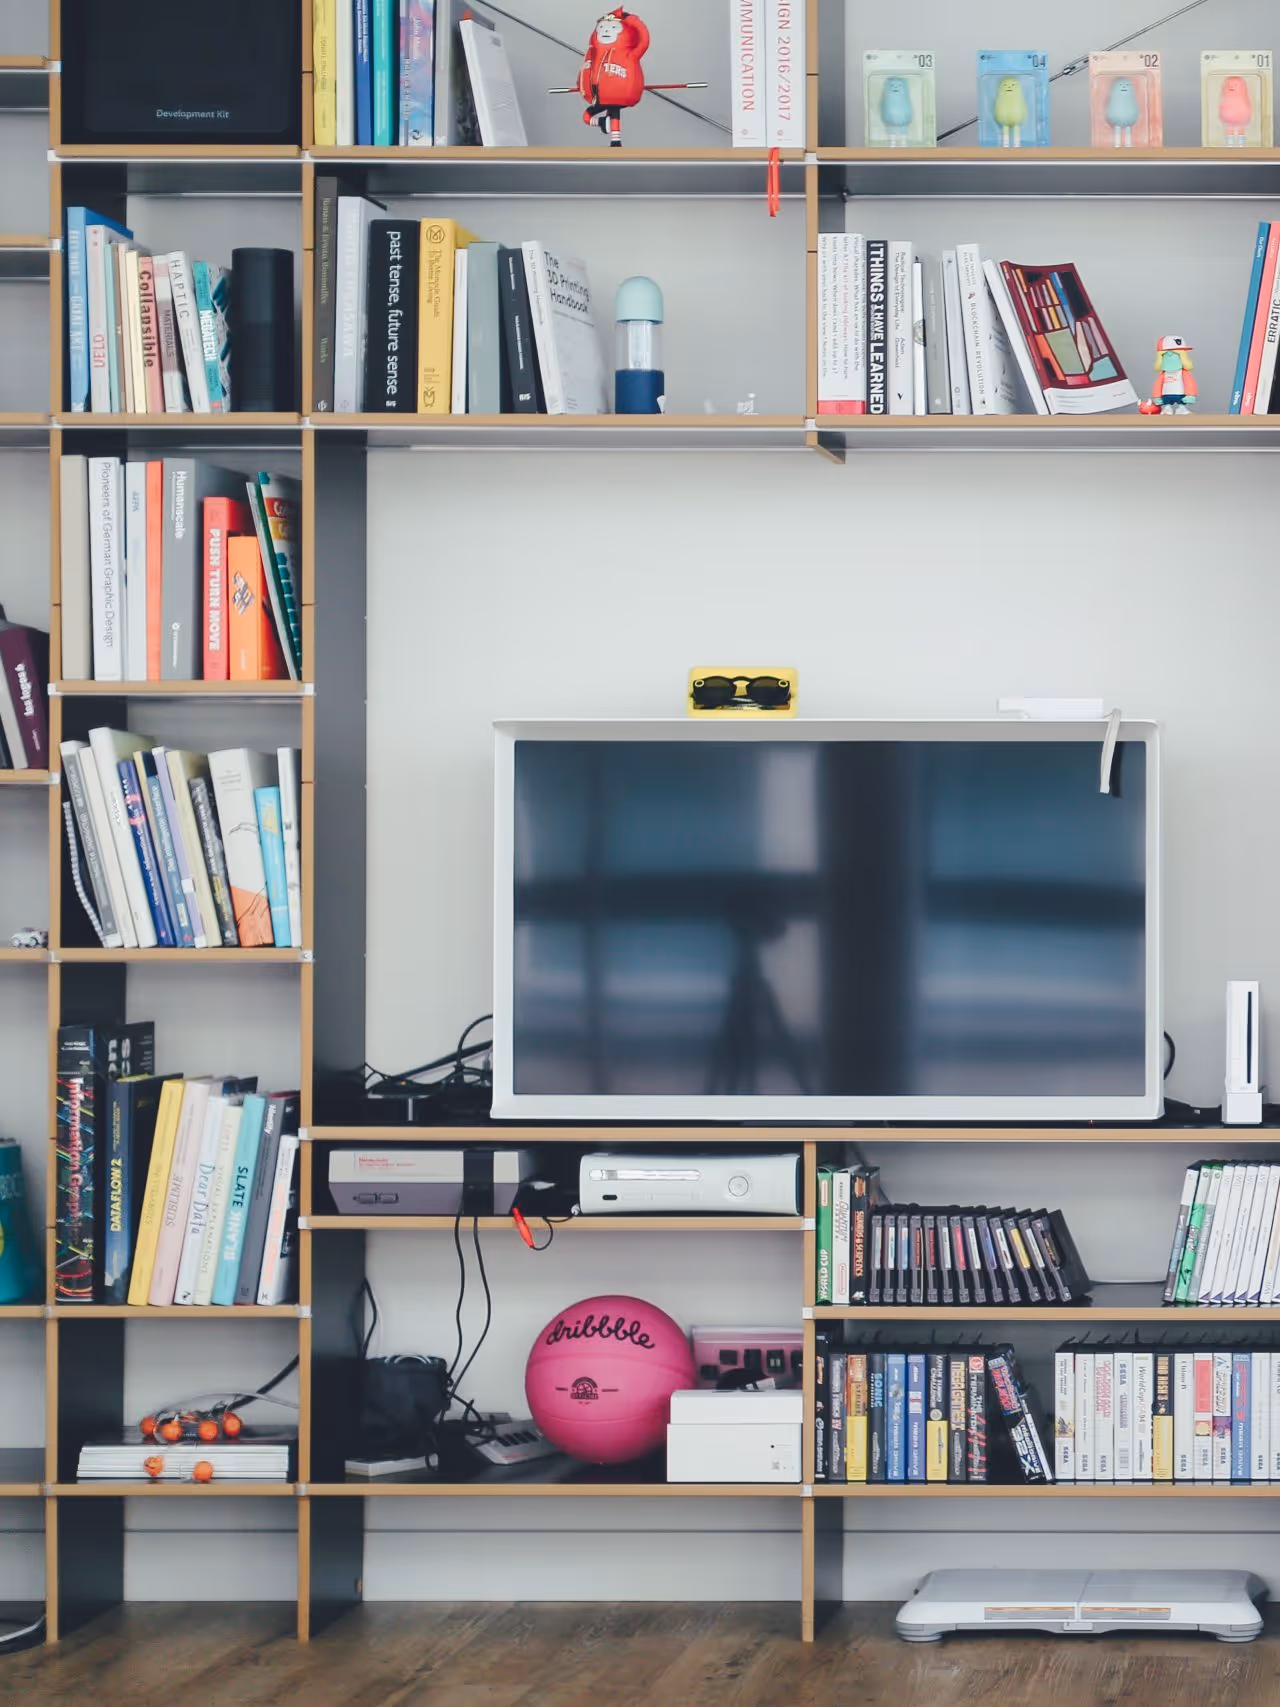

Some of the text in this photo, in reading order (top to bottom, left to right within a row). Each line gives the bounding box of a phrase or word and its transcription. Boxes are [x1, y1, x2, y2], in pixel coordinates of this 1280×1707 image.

[777, 36, 791, 121] 2016/2017
[918, 54, 932, 67] 03
[1032, 54, 1046, 68] 04
[1144, 54, 1159, 67] 02
[1257, 54, 1271, 68] 01
[156, 108, 230, 119] Development Kit
[543, 251, 559, 269] The
[169, 259, 190, 319] HAPTIC
[386, 231, 404, 395] past tense, future sense
[199, 310, 217, 361] MEGATECH
[870, 248, 884, 414] THINGS HAVE LEARNED
[1267, 299, 1280, 344] ERRATIC
[976, 351, 985, 395] REVOLUTION
[174, 471, 187, 538] Humanscale
[100, 462, 115, 648] Pioneers German Graphic Design
[208, 528, 220, 651] PUSH TURN MOVE
[68, 1078, 84, 1171] Information
[164, 1173, 184, 1228] SUBLIME
[190, 1163, 216, 1235] Dear Data
[223, 1165, 249, 1261] SLATE BLANK
[820, 1249, 829, 1299] WORLD CUP
[545, 1314, 655, 1349] dribbble
[970, 1374, 978, 1435] TERMINATOR
[1157, 1375, 1169, 1394] RASH
